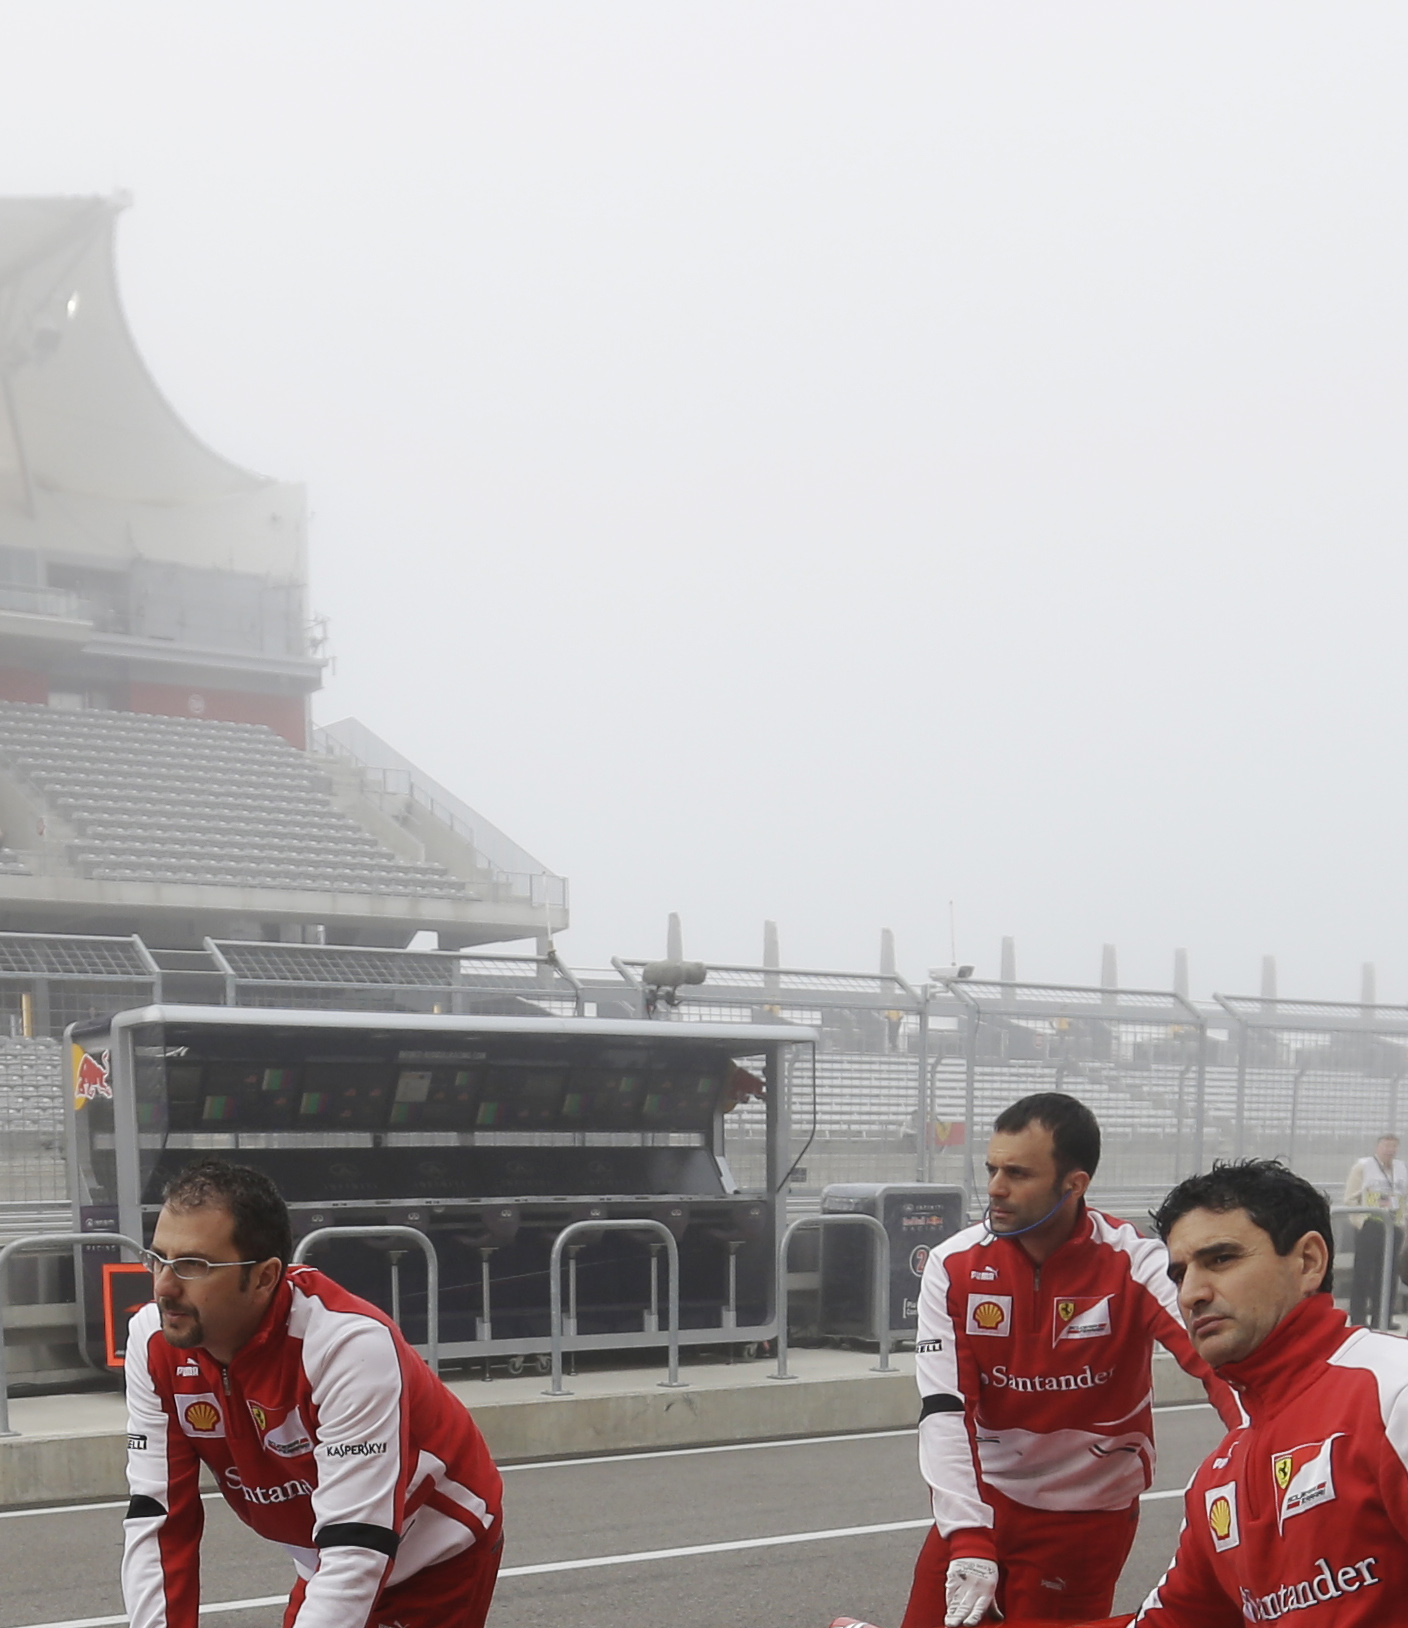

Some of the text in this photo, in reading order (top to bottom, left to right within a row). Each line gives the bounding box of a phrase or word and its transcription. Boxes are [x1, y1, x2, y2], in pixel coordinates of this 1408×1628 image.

[916, 1249, 928, 1273] 2
[992, 1364, 1116, 1392] Santander
[326, 1441, 382, 1458] KASPERSKY
[1248, 1557, 1380, 1620] ntander
